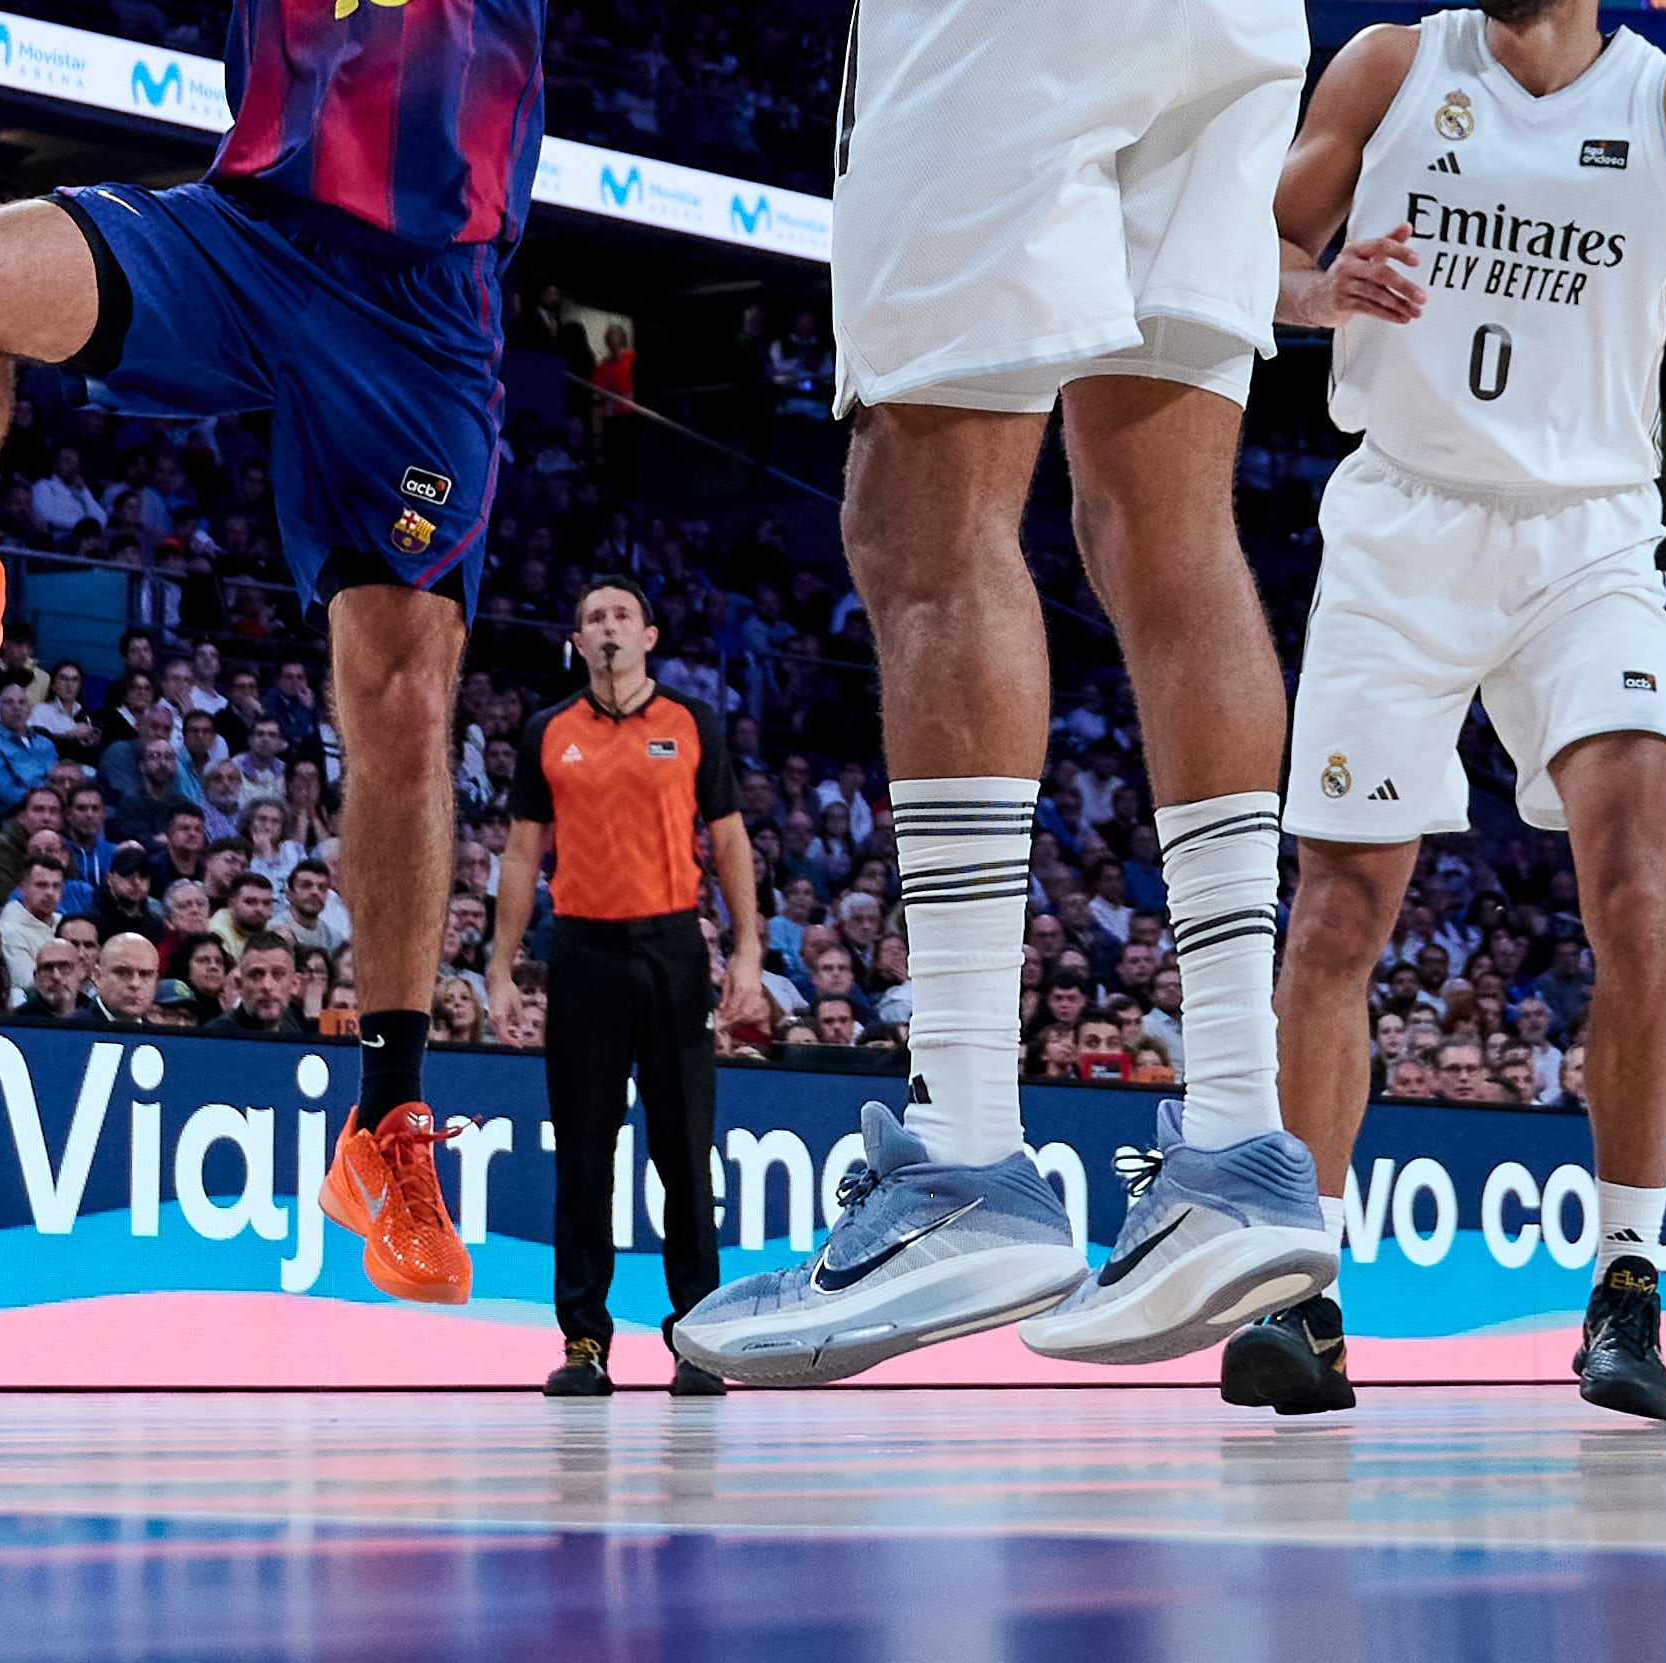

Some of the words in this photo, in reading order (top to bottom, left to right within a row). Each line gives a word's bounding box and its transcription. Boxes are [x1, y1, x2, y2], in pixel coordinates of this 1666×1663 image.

[19, 41, 87, 71] Movistar
[190, 79, 225, 101] Movi
[1406, 192, 1625, 269] Emirates
[1429, 251, 1479, 291] FLY
[1485, 260, 1587, 306] BETTER
[1469, 323, 1512, 402] 0
[406, 479, 436, 498] acb
[1624, 676, 1652, 689] acb
